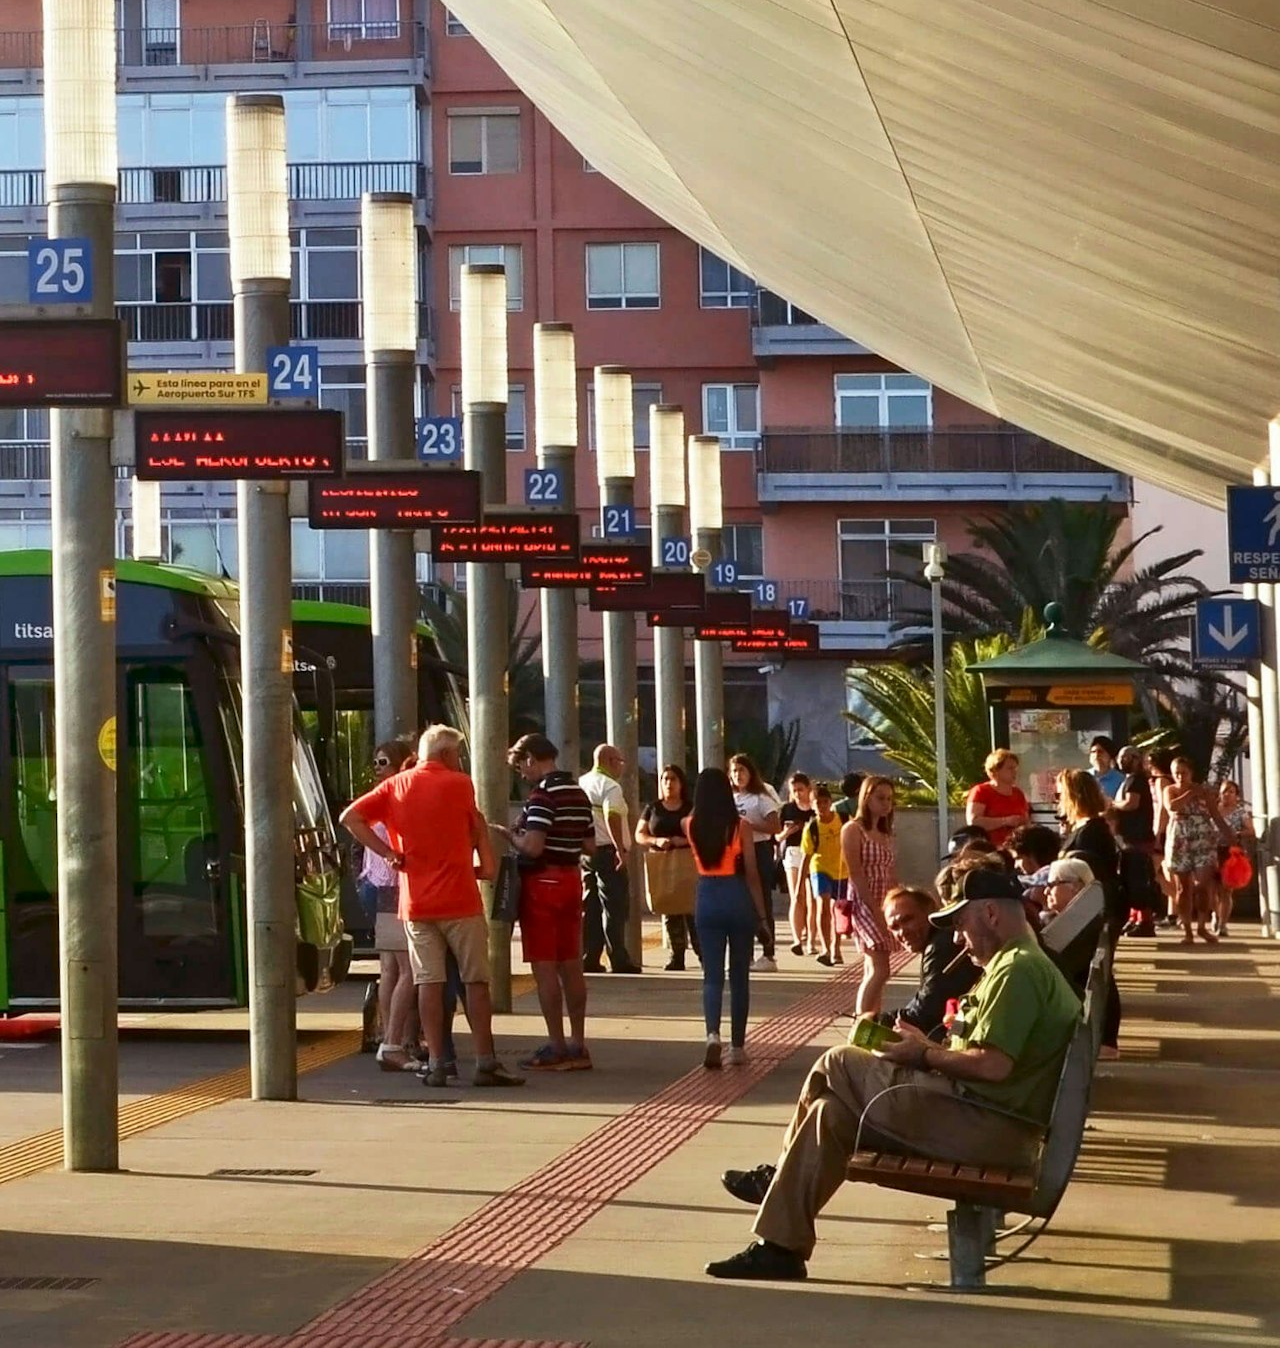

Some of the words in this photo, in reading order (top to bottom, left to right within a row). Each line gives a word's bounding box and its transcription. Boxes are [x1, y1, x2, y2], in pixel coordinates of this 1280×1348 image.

[36, 247, 85, 293] 25
[273, 353, 313, 390] 24
[157, 379, 179, 388] Esta
[209, 381, 234, 390] para
[251, 379, 261, 388] el
[157, 390, 216, 400] Aeropuerto
[218, 390, 235, 398] Sur
[236, 390, 255, 398] TFS
[422, 423, 456, 454] 23
[529, 473, 558, 500] 22
[607, 509, 630, 532] 21
[664, 541, 688, 562] 20
[715, 564, 735, 583] 19
[1249, 564, 1280, 579] SEÑ
[757, 583, 776, 602] 18
[789, 600, 806, 616] 17
[14, 623, 54, 639] titsa
